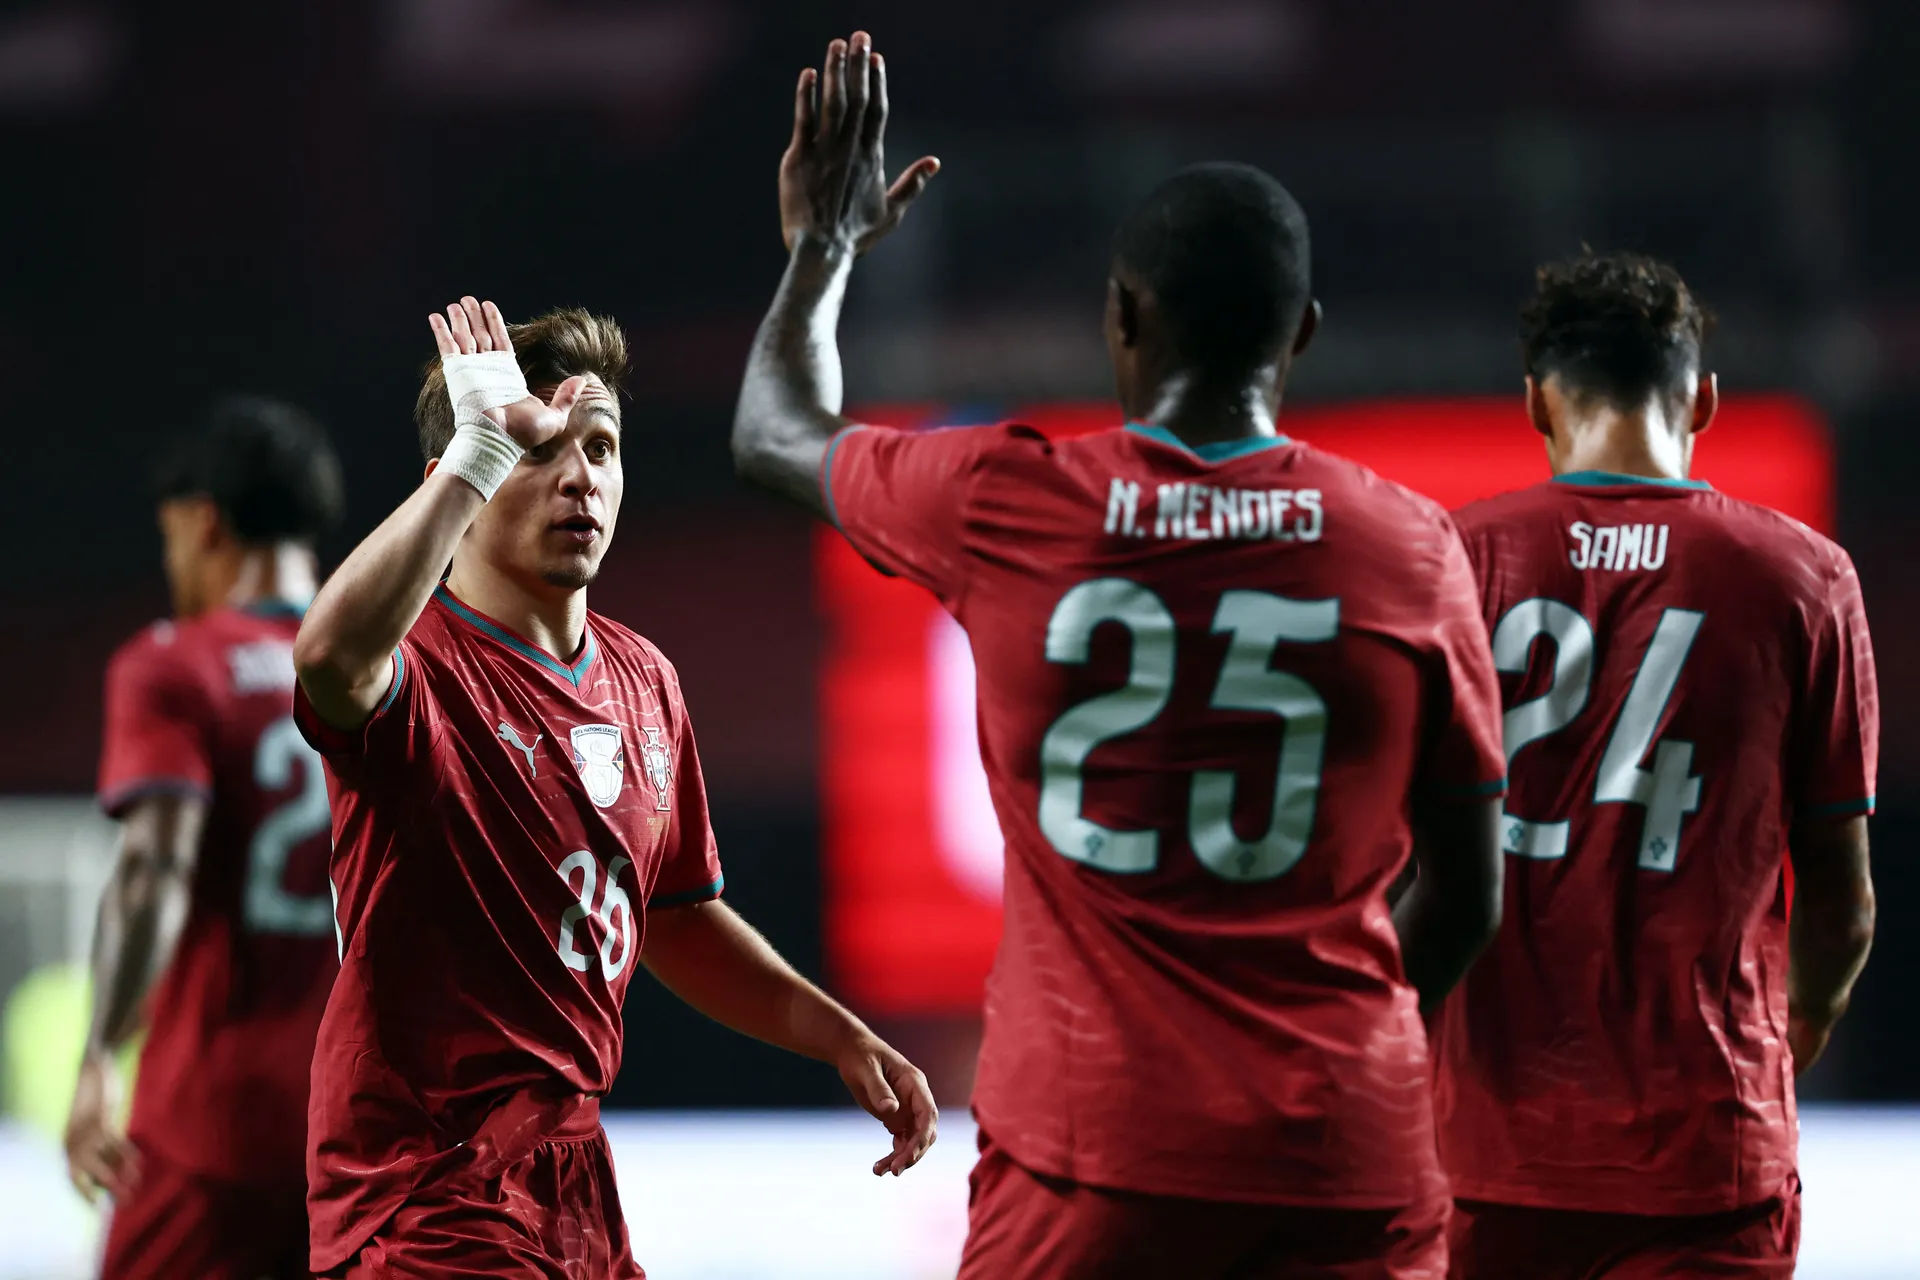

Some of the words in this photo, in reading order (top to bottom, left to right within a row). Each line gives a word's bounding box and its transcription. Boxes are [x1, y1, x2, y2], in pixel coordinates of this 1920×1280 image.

[1104, 477, 1145, 537] N.
[1154, 481, 1324, 542] MENDES
[1569, 520, 1669, 571] SAMU
[1038, 577, 1340, 883] 25
[1492, 597, 1706, 873] 24
[557, 850, 632, 982] 26
